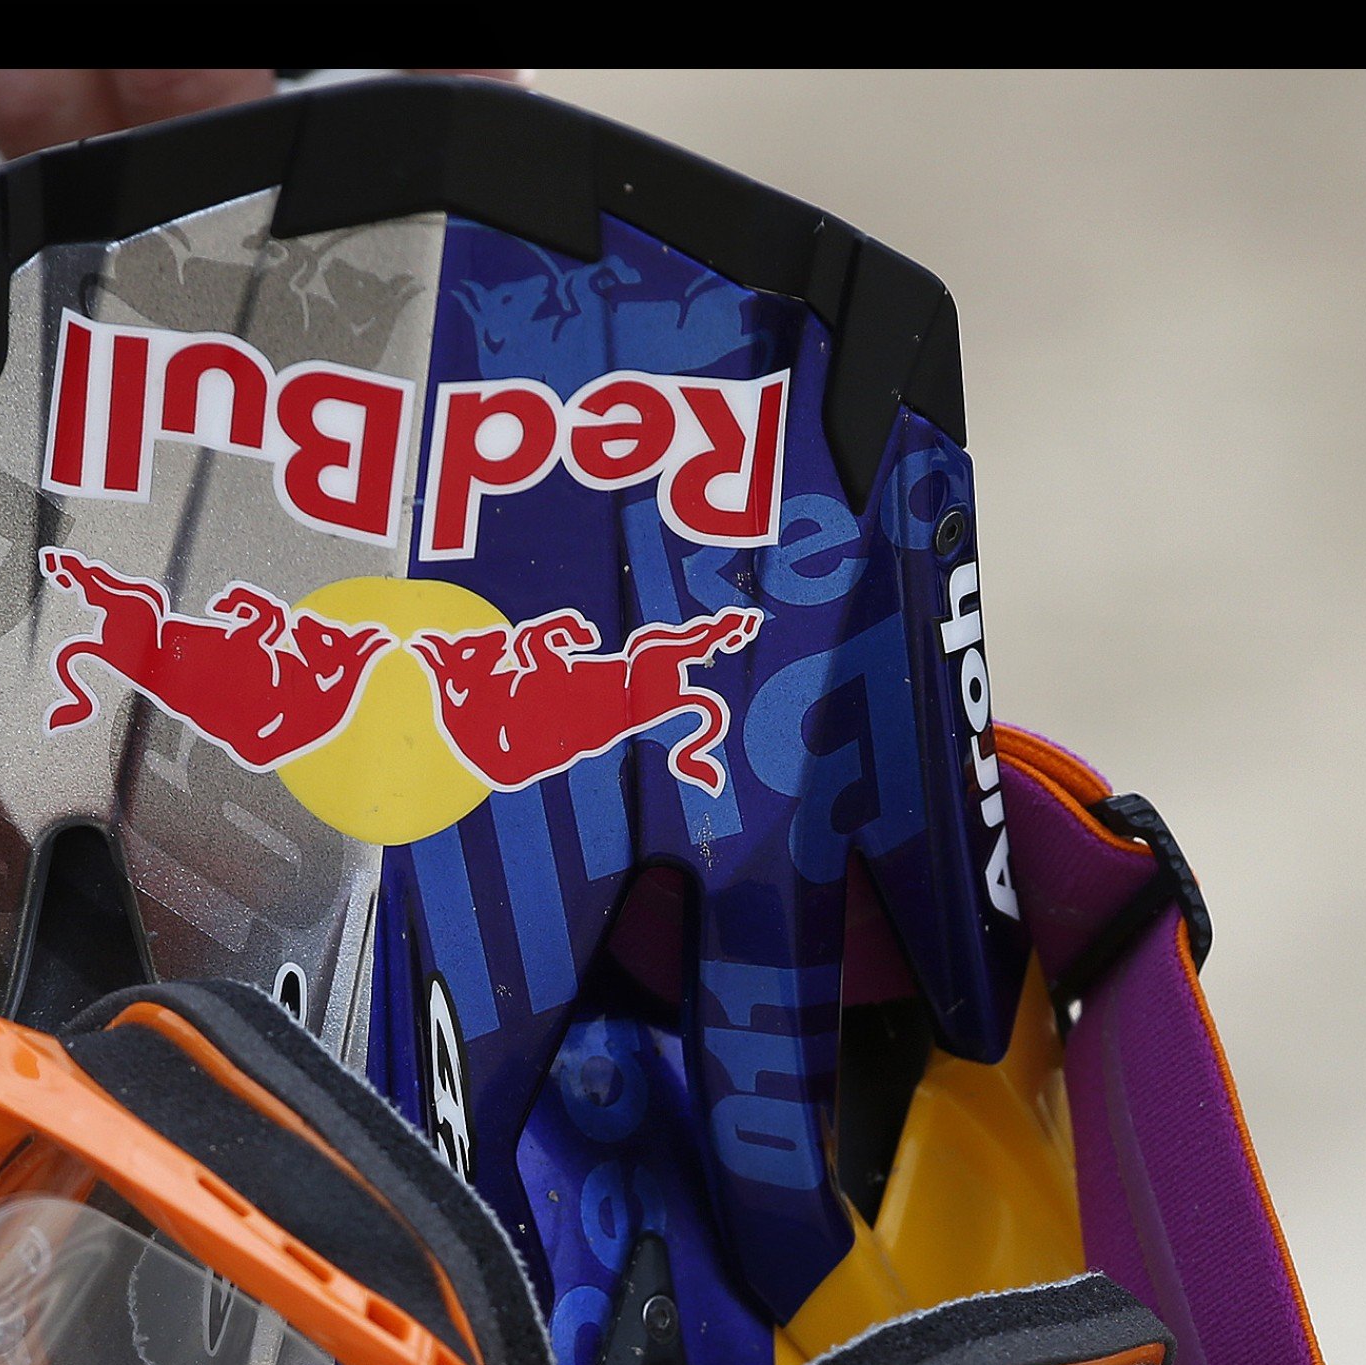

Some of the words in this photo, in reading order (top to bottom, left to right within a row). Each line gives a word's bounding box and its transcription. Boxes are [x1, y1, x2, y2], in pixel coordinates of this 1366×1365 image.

[42, 308, 415, 547] Bull
[420, 370, 790, 560] Red
[939, 562, 1021, 921] Airoh
